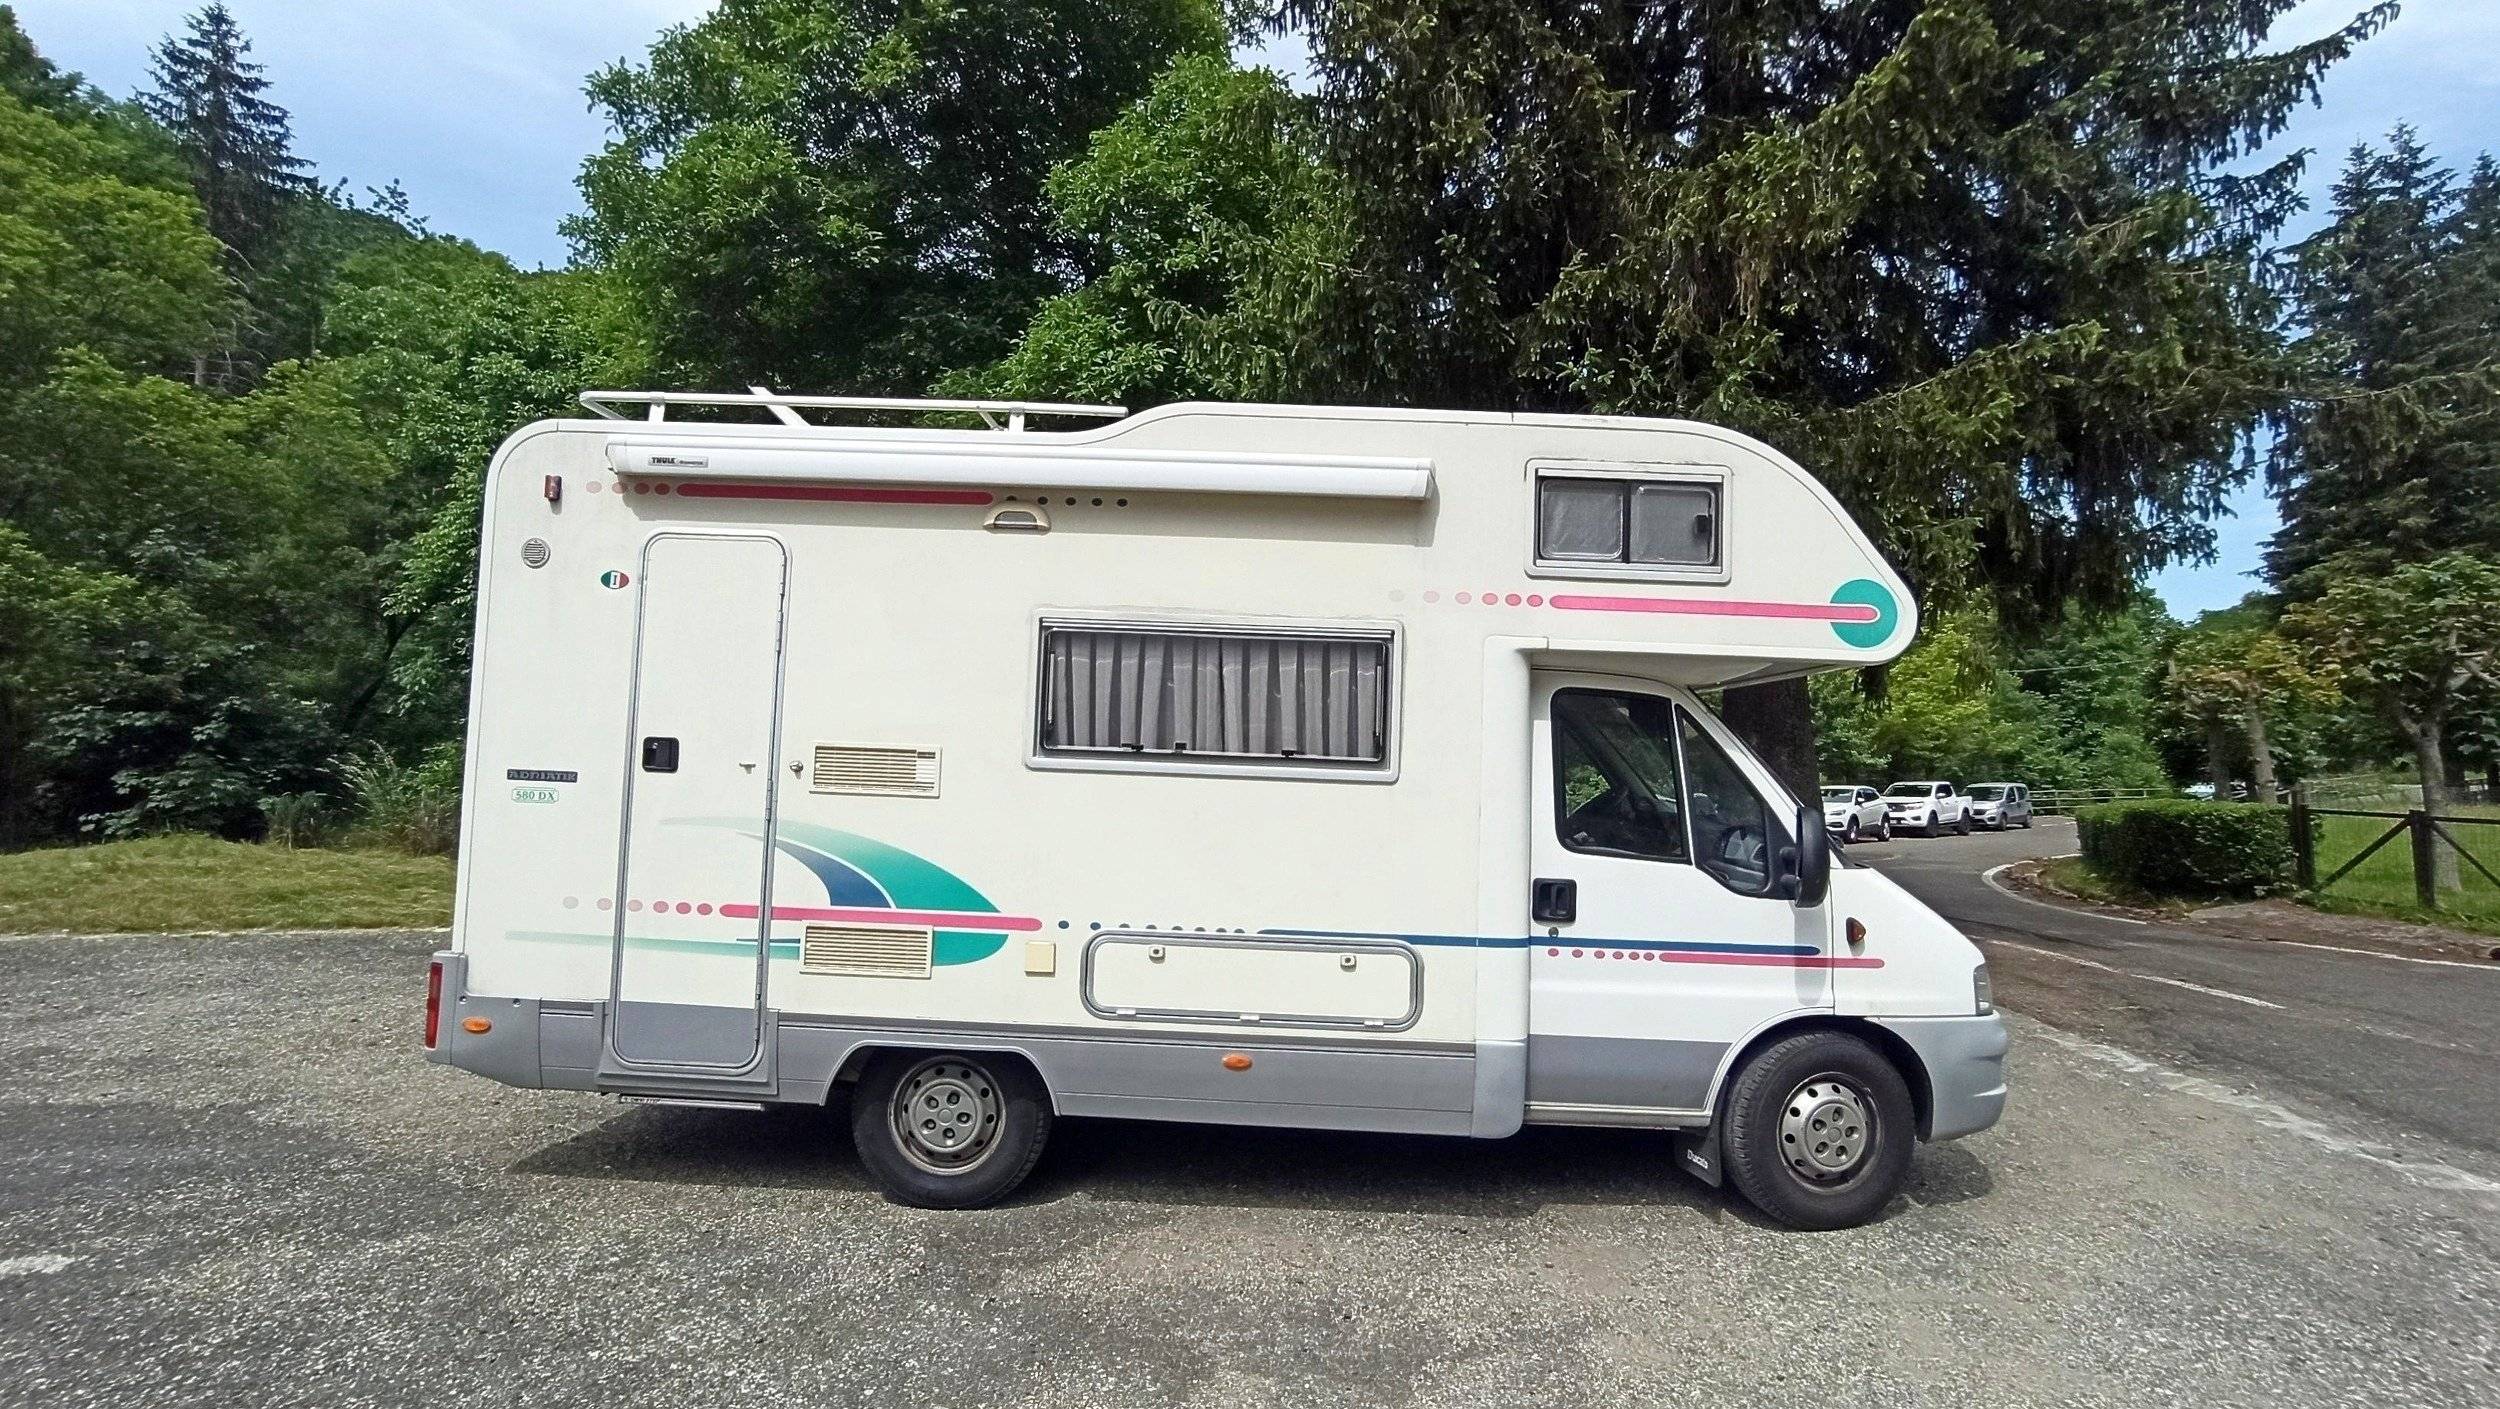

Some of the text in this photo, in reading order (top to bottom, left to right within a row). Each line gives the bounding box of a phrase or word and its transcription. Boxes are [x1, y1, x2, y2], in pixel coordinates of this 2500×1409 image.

[651, 456, 676, 464] THULE
[516, 790, 554, 801] 580 DX
